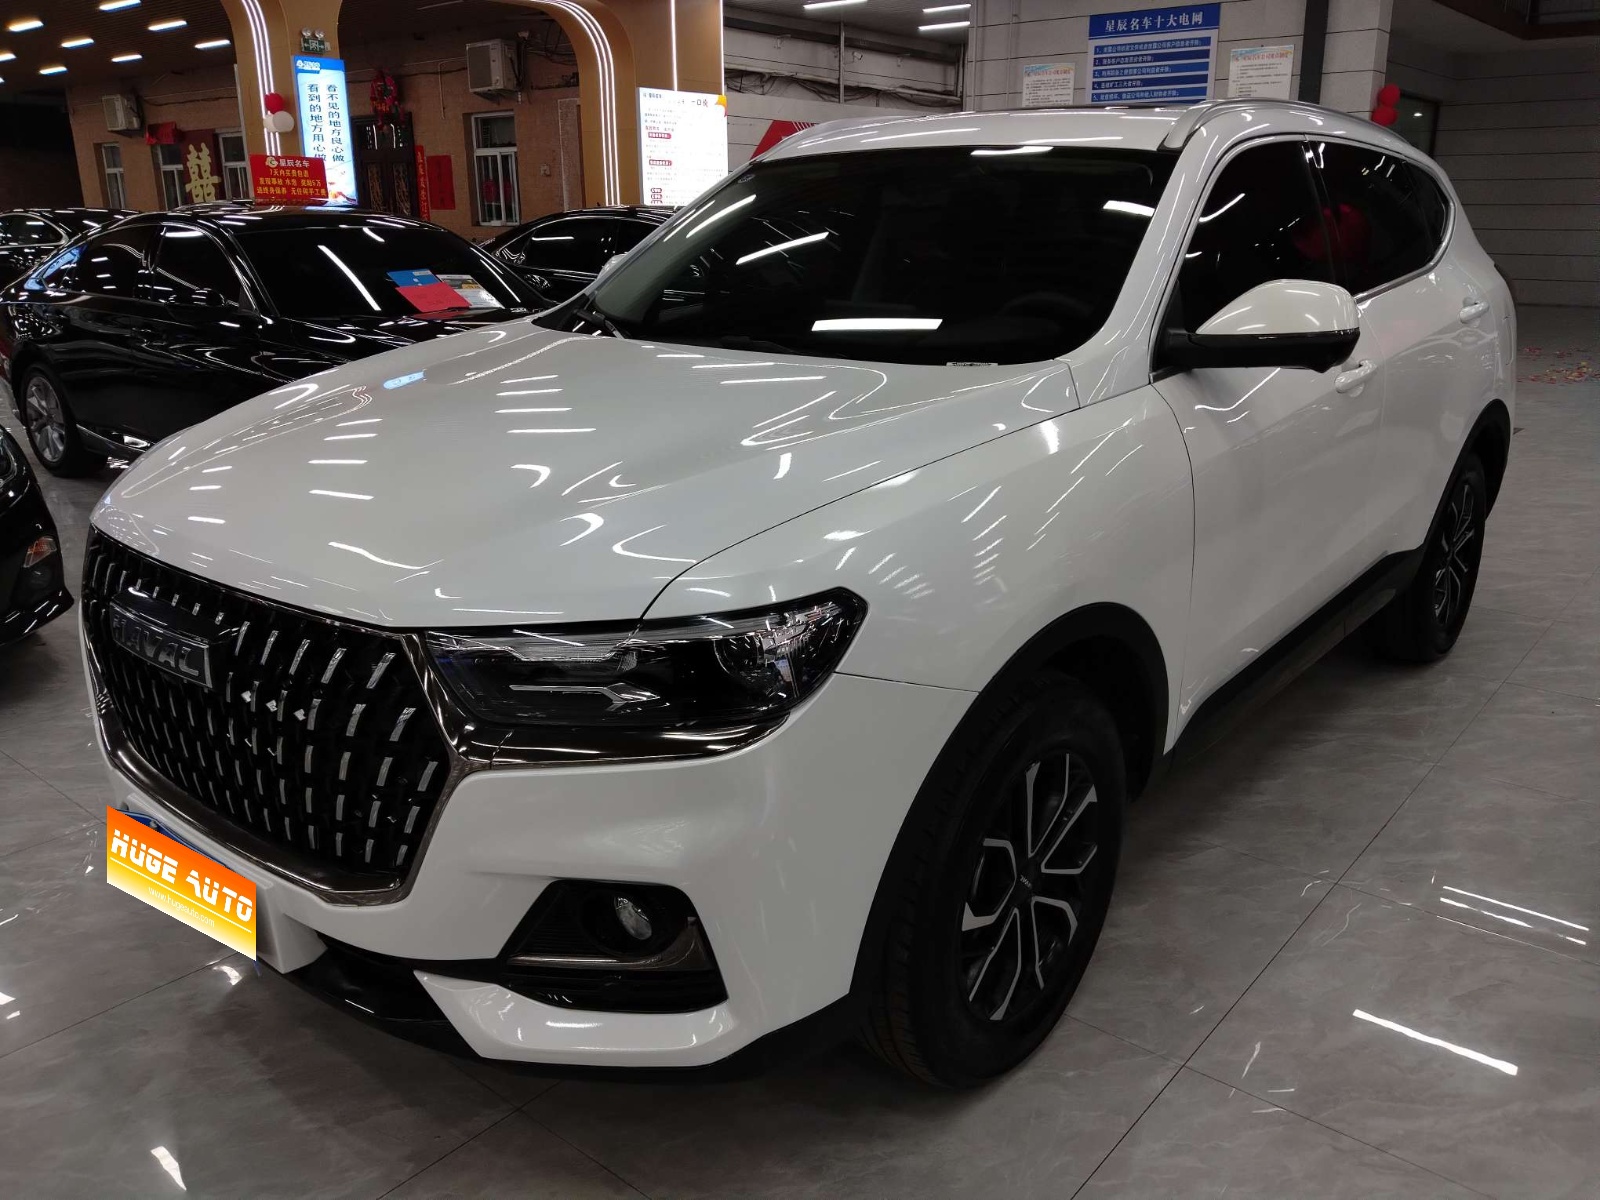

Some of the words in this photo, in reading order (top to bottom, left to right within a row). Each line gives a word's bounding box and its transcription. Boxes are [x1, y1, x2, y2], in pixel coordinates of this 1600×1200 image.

[1105, 11, 1203, 33] 星辰名车十大电网
[326, 84, 345, 162] 看不见的地方良心做
[279, 158, 310, 168] 星辰名车
